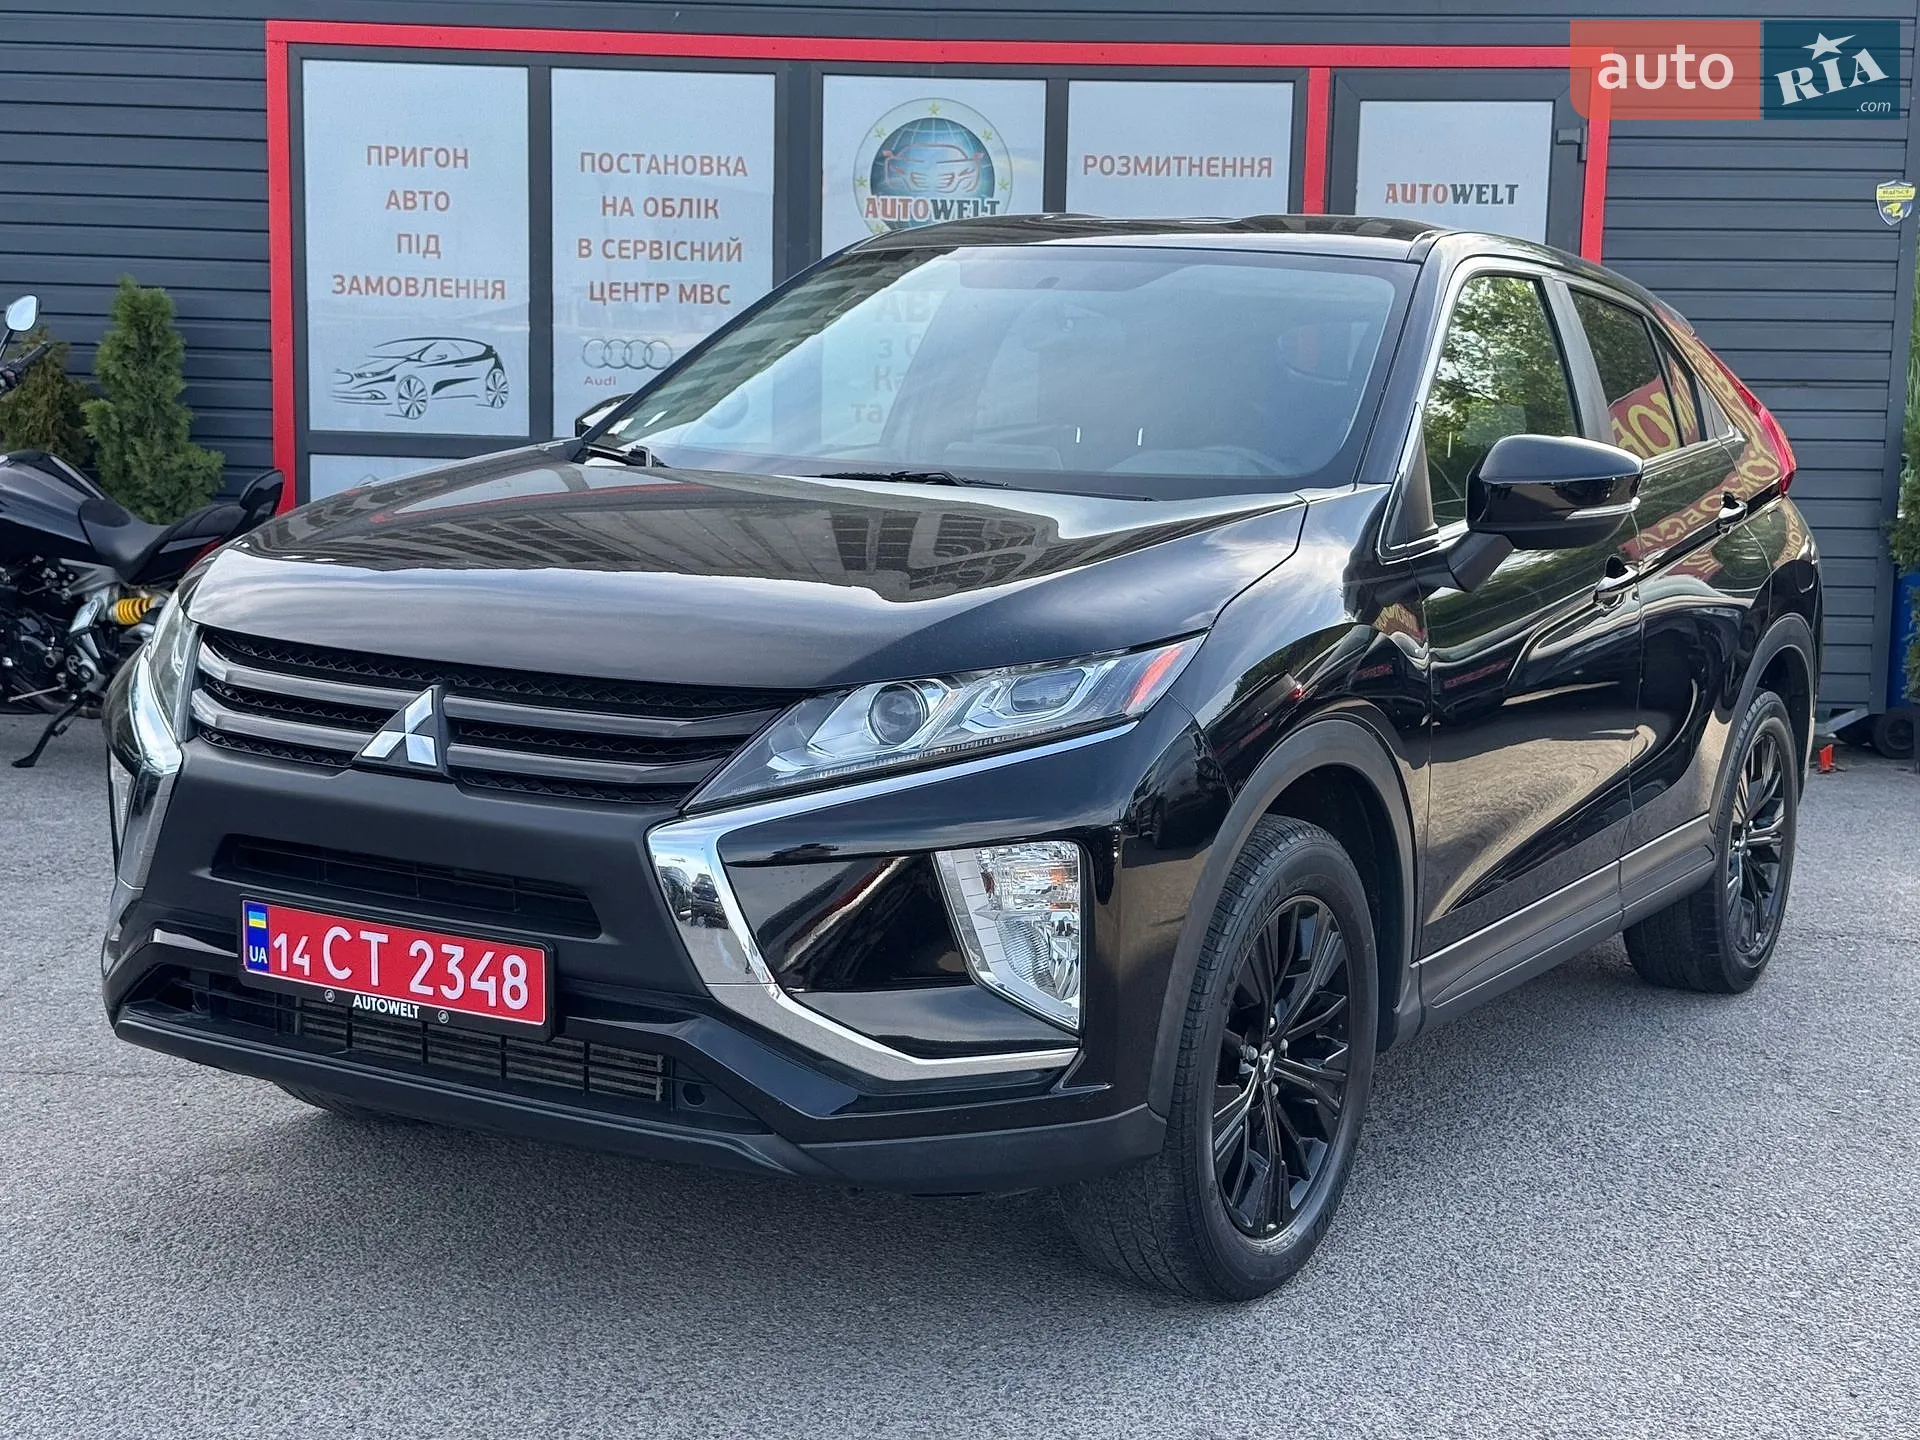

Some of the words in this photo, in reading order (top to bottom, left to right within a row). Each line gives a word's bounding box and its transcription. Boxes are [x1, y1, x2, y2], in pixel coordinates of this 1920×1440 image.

[366, 145, 470, 170] ПРИГОН
[580, 152, 748, 178] ПОСТАНОВКА
[1083, 155, 1273, 178] РОЗМИТНЕННЯ
[385, 190, 451, 212] АВТО
[1384, 183, 1519, 205] AUTOWELT
[601, 197, 634, 217] НА
[643, 197, 720, 220] ОБЛІК
[865, 197, 1000, 221] AUTOWELT
[397, 234, 442, 259] ПІД
[577, 239, 592, 260] В
[601, 237, 743, 263] СЕРВІСНИЙ
[331, 275, 506, 301] ЗАМОВЛЕННЯ
[589, 281, 670, 305] ЦЕНТР
[678, 284, 732, 306] МВС
[584, 376, 617, 386] Audi
[249, 945, 268, 964] UA
[273, 933, 311, 976] 14
[409, 939, 529, 1010] 2348
[352, 994, 420, 1019] AUTOWELT
